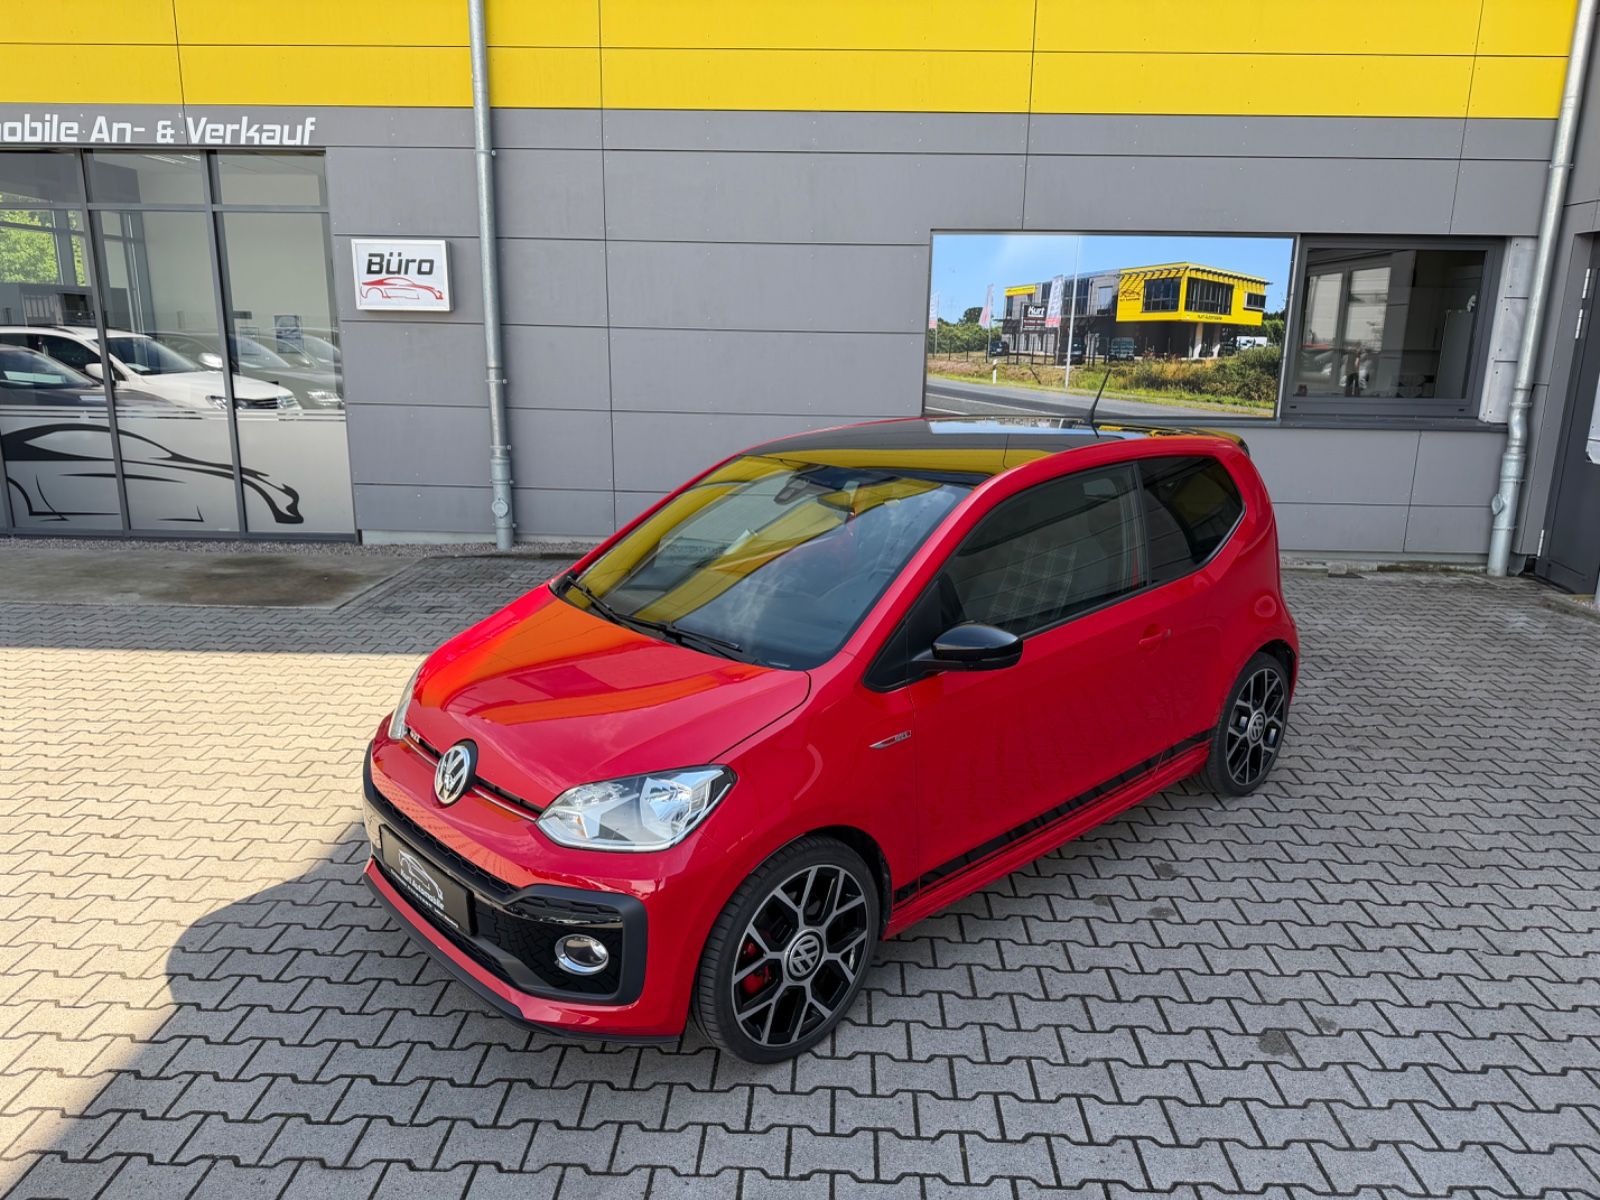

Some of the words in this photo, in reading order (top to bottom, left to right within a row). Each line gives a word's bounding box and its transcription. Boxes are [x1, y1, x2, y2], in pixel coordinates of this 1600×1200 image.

[0, 113, 79, 143] obile
[90, 115, 146, 143] An-
[156, 120, 175, 143] &
[186, 116, 316, 145] Verkauf
[366, 252, 435, 275] Büro
